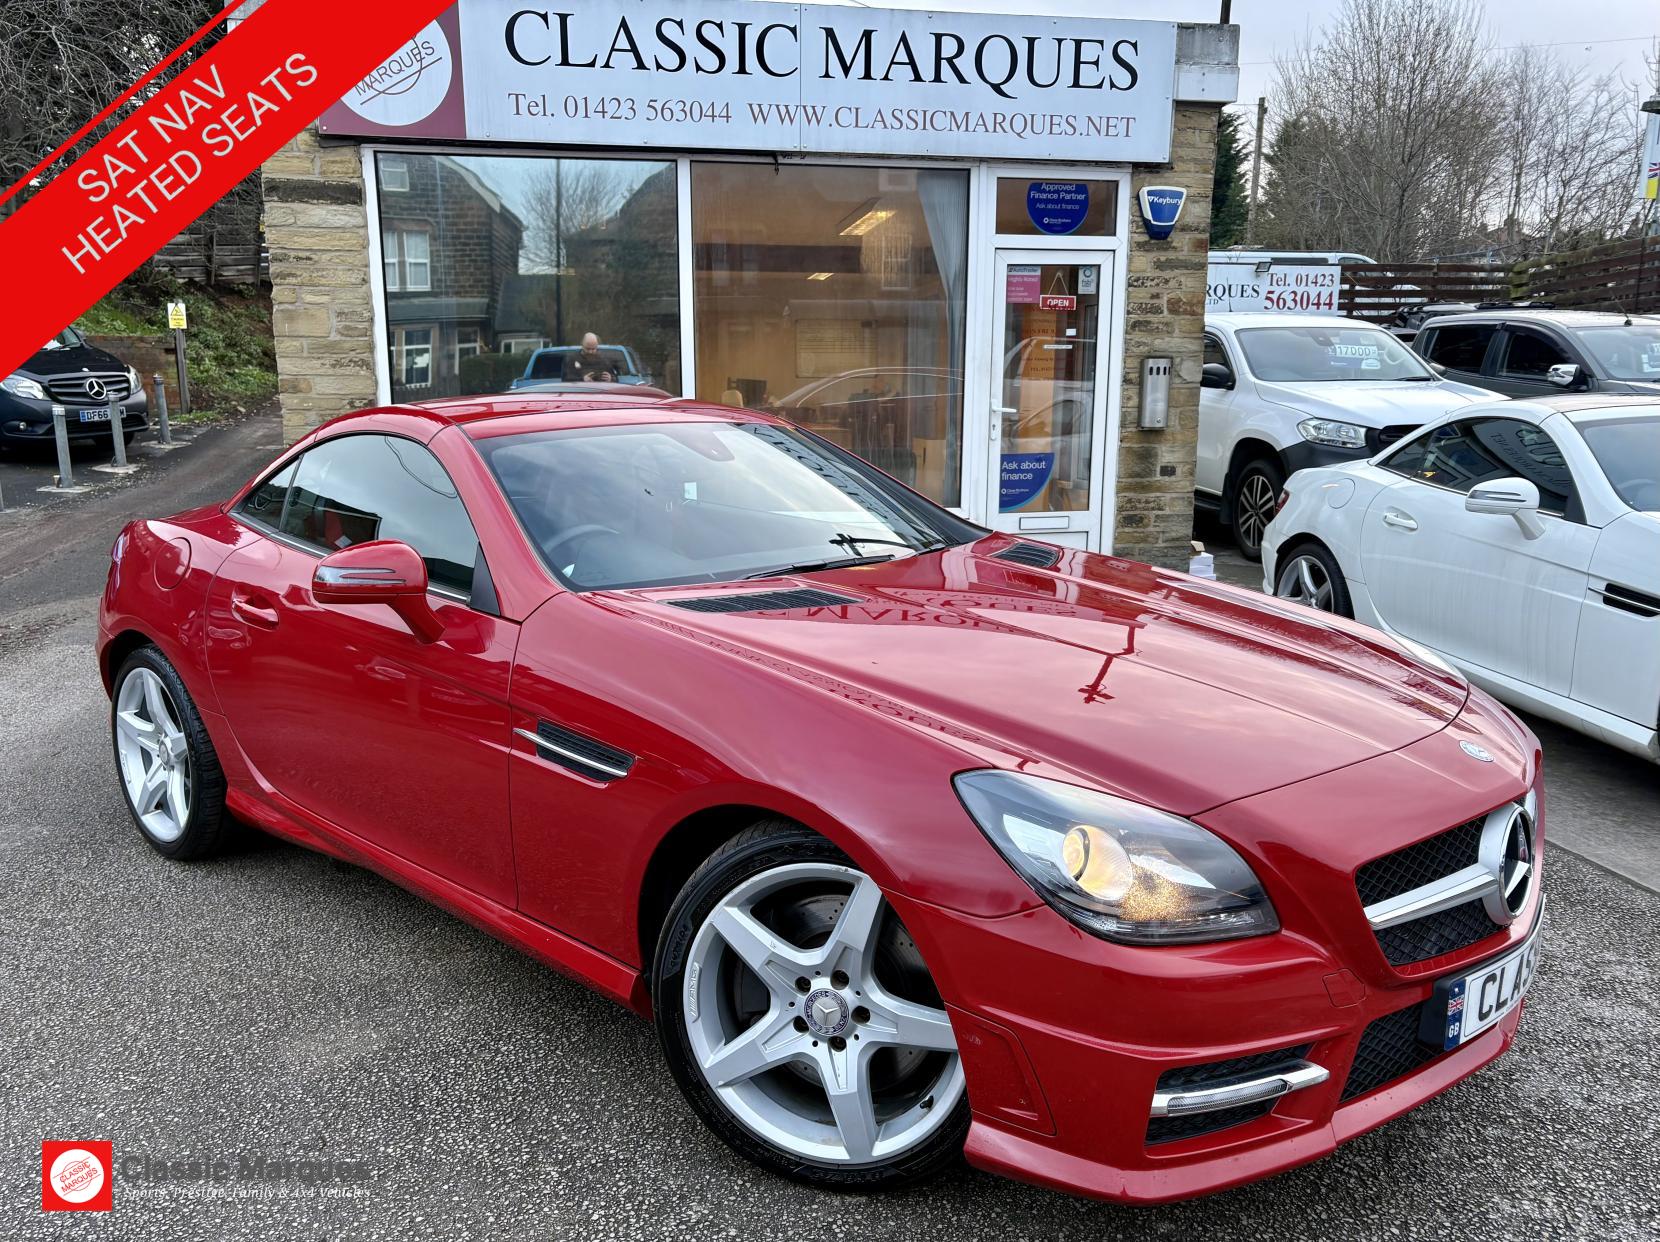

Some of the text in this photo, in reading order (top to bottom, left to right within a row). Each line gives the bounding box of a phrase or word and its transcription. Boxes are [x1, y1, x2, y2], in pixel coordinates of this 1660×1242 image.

[505, 10, 1139, 99] CLASSIC MARQUES
[354, 40, 435, 97] MARQUES
[508, 93, 1136, 139] Tel. 01423 563044 WWW.CLASSICMARQUES.NET
[1041, 182, 1076, 191] Approved
[1030, 191, 1086, 200] Finance Partner
[1267, 273, 1335, 288] Tel. 01423
[1047, 298, 1070, 307] OPEN
[1263, 290, 1334, 311] 563044
[1001, 460, 1046, 470] Ask about
[1001, 472, 1033, 481] finance
[1448, 1022, 1460, 1039] GB
